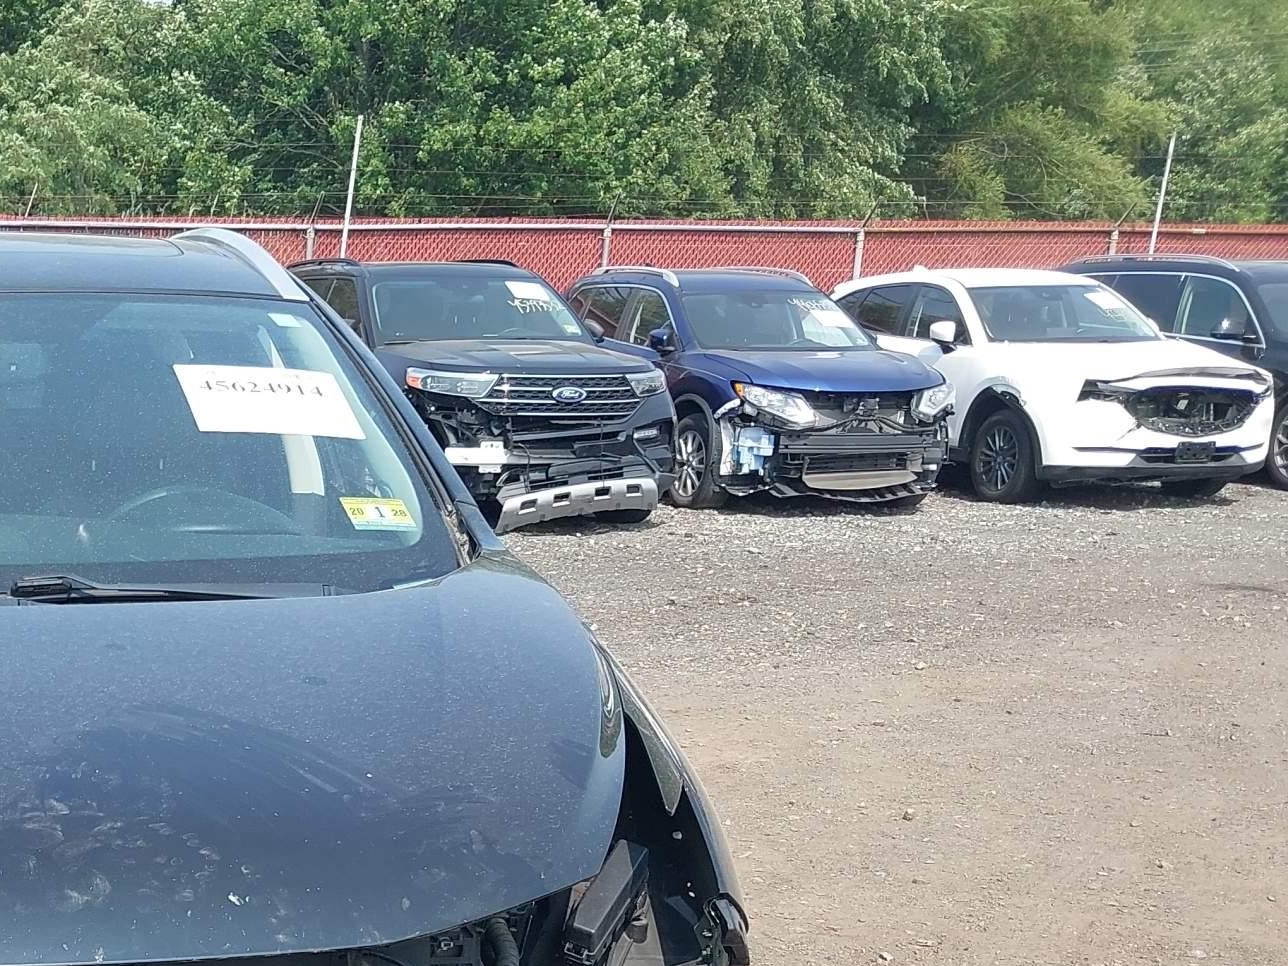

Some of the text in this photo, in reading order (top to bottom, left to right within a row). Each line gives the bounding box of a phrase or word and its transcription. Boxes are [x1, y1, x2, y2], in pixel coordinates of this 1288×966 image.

[199, 380, 324, 397] 45624914
[349, 507, 365, 516] 20
[374, 506, 386, 518] 1
